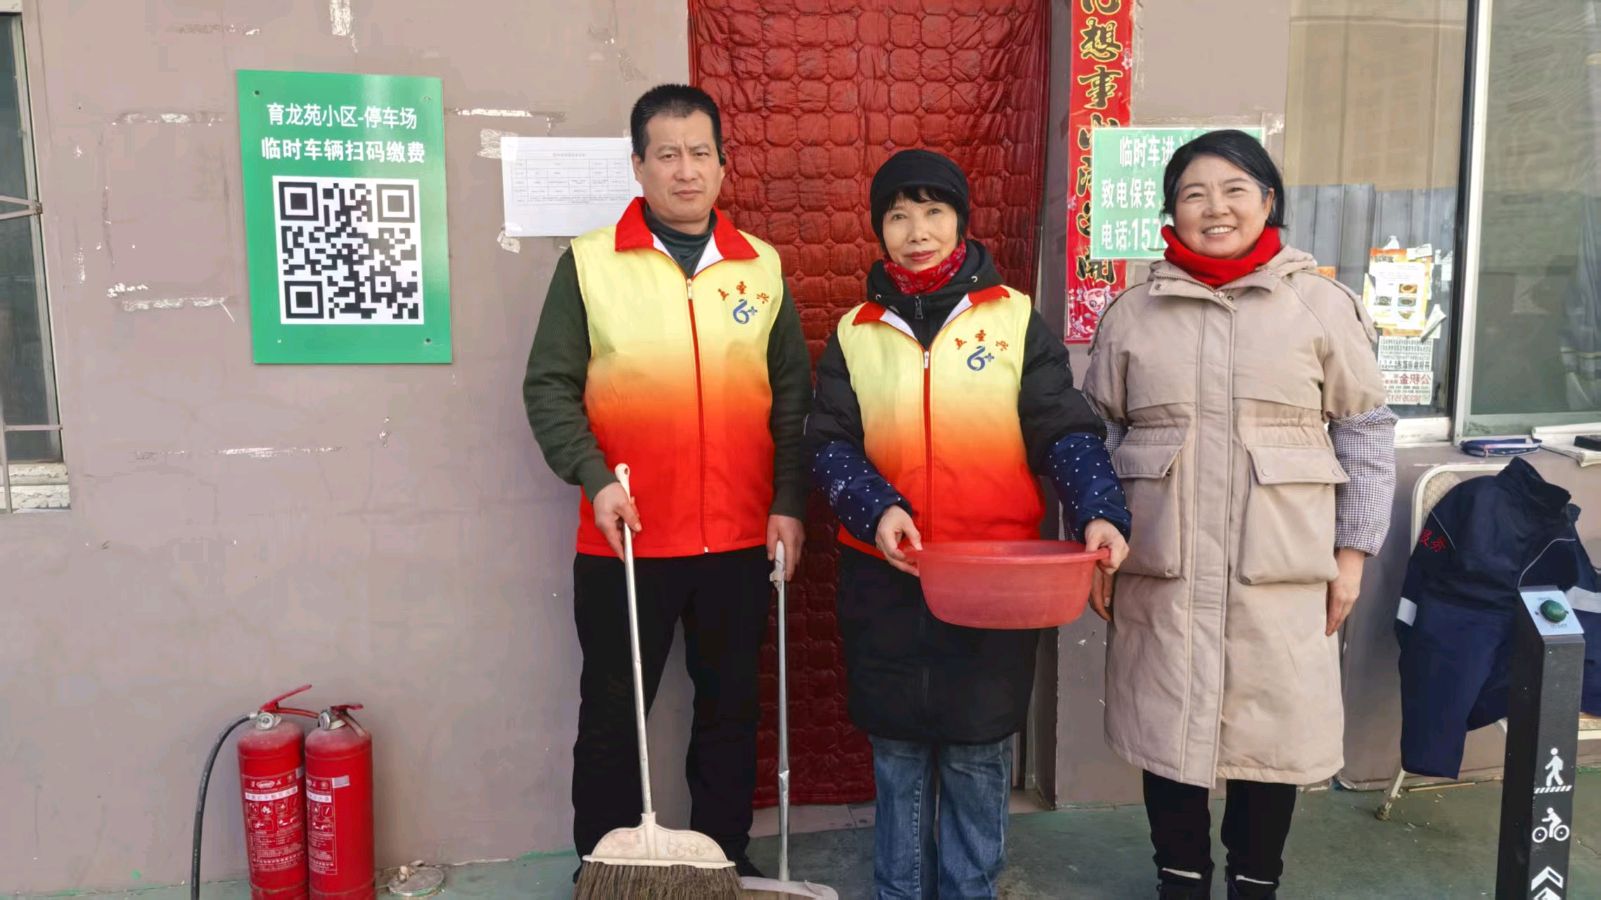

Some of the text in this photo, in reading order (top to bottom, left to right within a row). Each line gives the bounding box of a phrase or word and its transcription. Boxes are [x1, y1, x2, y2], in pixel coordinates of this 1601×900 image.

[266, 102, 418, 130] 育龙苑小区-停车场
[261, 137, 426, 163] 临时车辆扫码缴费
[1120, 134, 1184, 168] 临时车进
